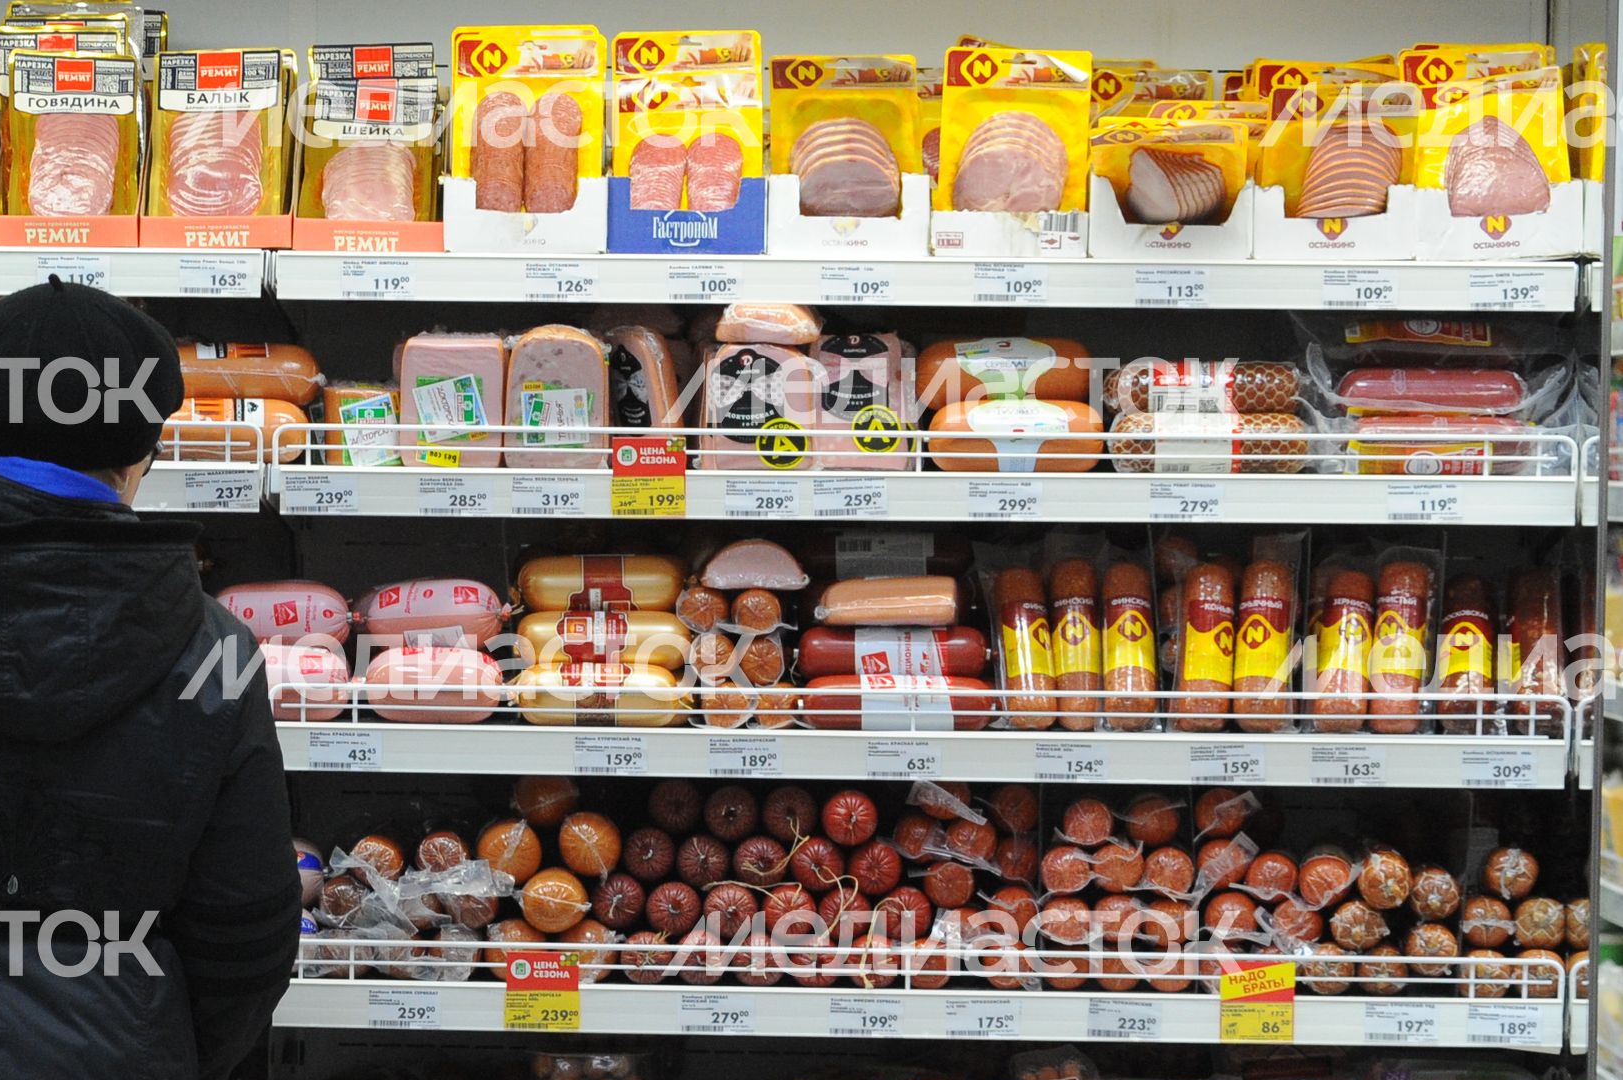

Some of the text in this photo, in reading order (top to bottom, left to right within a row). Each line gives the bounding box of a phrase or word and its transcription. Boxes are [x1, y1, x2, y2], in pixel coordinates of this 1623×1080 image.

[313, 52, 351, 61] НАРЕЗКА
[15, 60, 53, 69] НАРЕЗКА
[161, 58, 195, 66] НАРЕЗКА
[200, 67, 239, 77] РЕМИТ
[356, 62, 389, 73] РЕМИТ
[58, 73, 91, 83] РЕМИТ
[186, 91, 250, 104] БАЛЫК
[28, 97, 121, 109] ГОВЯДИНА
[359, 101, 393, 111] РЕМИТ
[342, 123, 405, 136] ШЕЙКА
[24, 228, 90, 244] РЕМИТ
[185, 230, 250, 247] РЕМИТ
[333, 236, 398, 252] РЕМИТ
[640, 447, 665, 456] ЦЕНА
[640, 456, 677, 465] СЕЗОНА
[533, 961, 559, 970] ЦЕНА
[533, 969, 570, 979] СЕЗОНА
[1228, 969, 1266, 985] НАДО
[1243, 977, 1285, 994] БРАТЬ!
